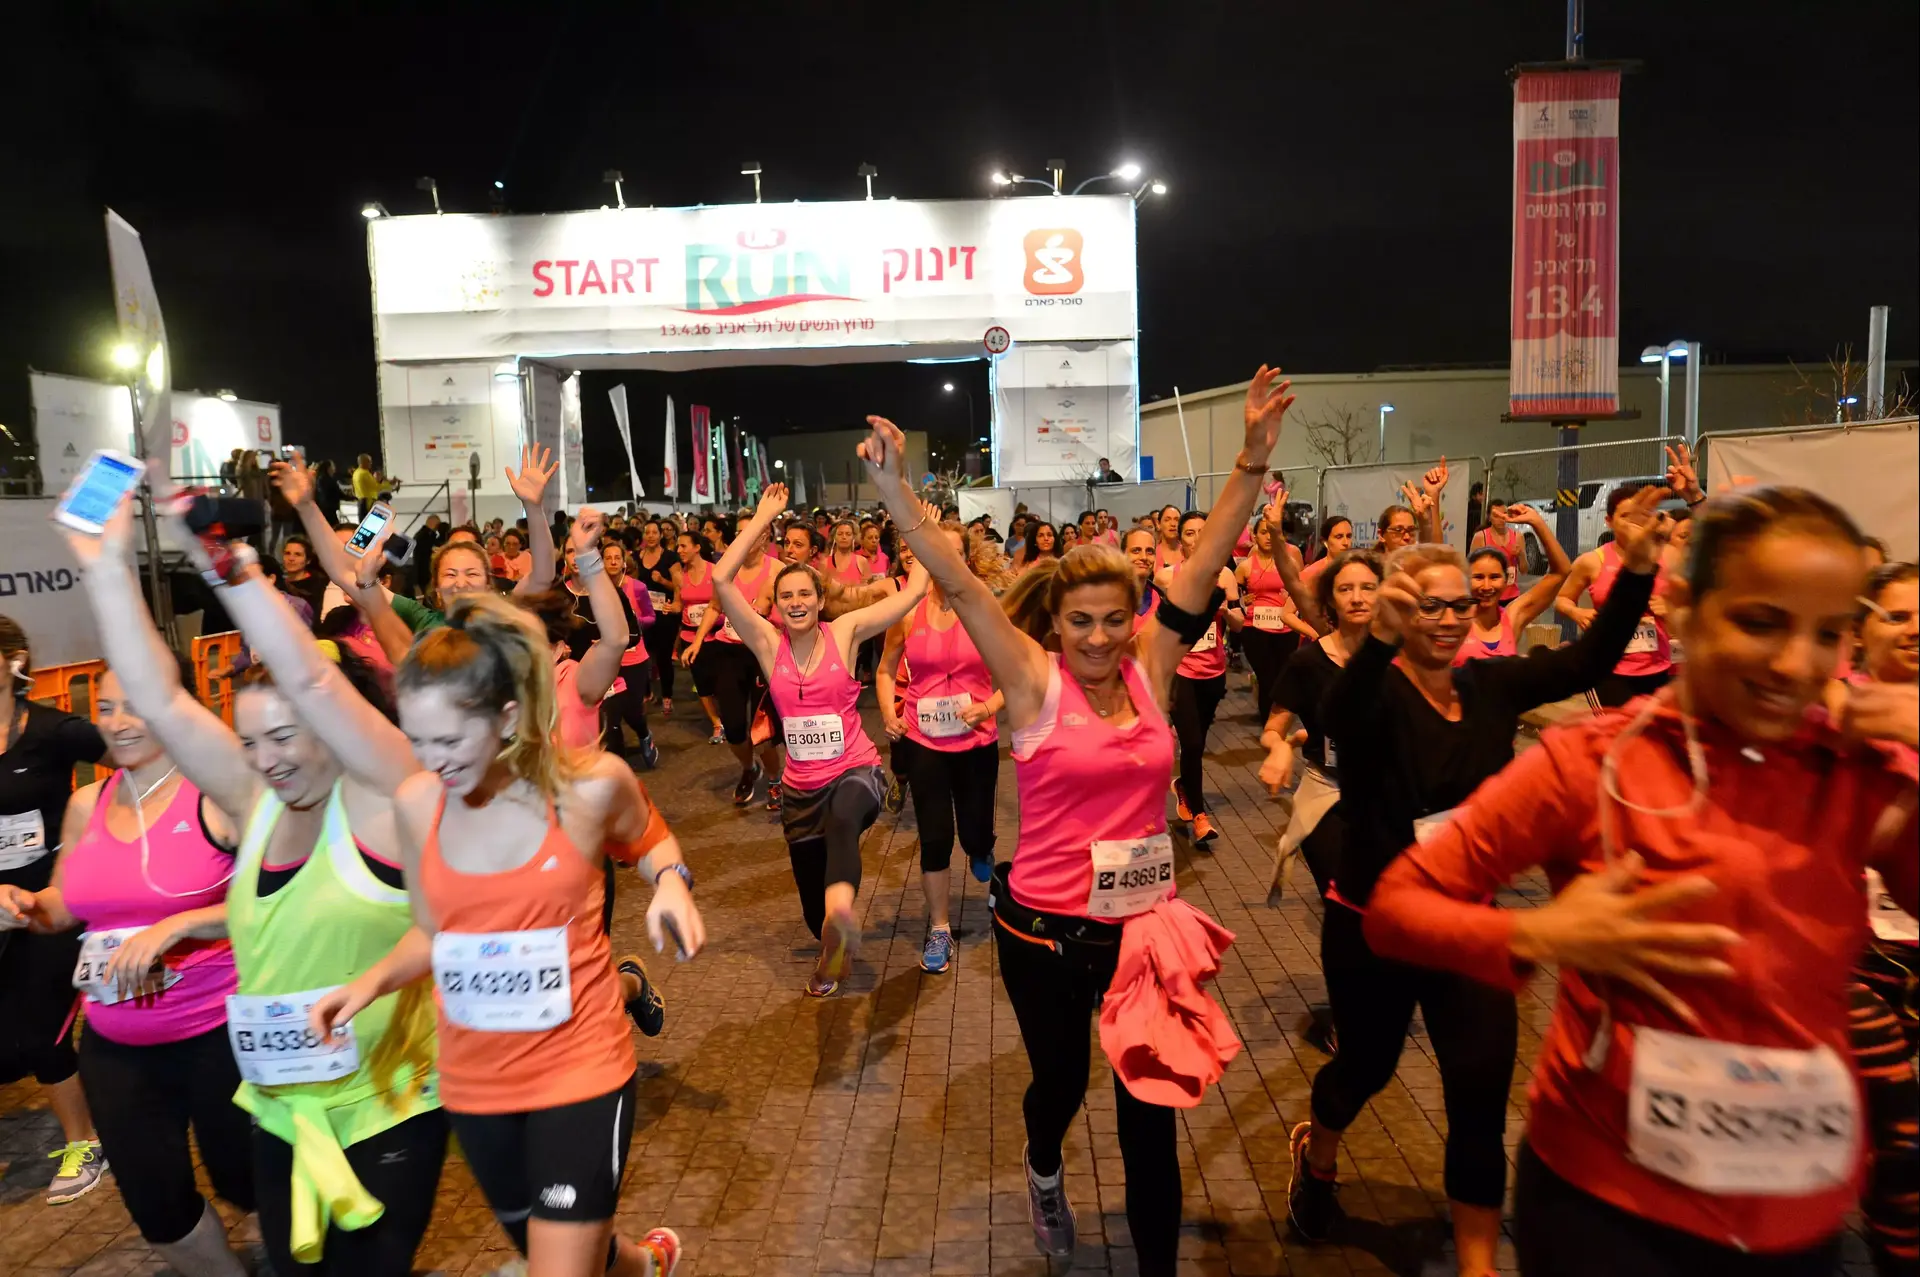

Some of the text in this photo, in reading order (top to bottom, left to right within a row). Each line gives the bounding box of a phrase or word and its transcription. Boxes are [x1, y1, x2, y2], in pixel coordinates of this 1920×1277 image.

[1529, 157, 1605, 193] RUN
[1526, 201, 1607, 221] מרוץ הנשים
[1554, 230, 1577, 248] של
[532, 257, 660, 297] START
[685, 243, 851, 310] RUN
[882, 246, 978, 293] זינוק
[1526, 284, 1604, 320] 13.4
[660, 323, 711, 337] 13.4.16
[775, 317, 796, 332] של
[800, 319, 840, 332] הנשים
[843, 317, 875, 334] מרוץ
[798, 732, 827, 745] 3031
[1119, 867, 1157, 889] 4369
